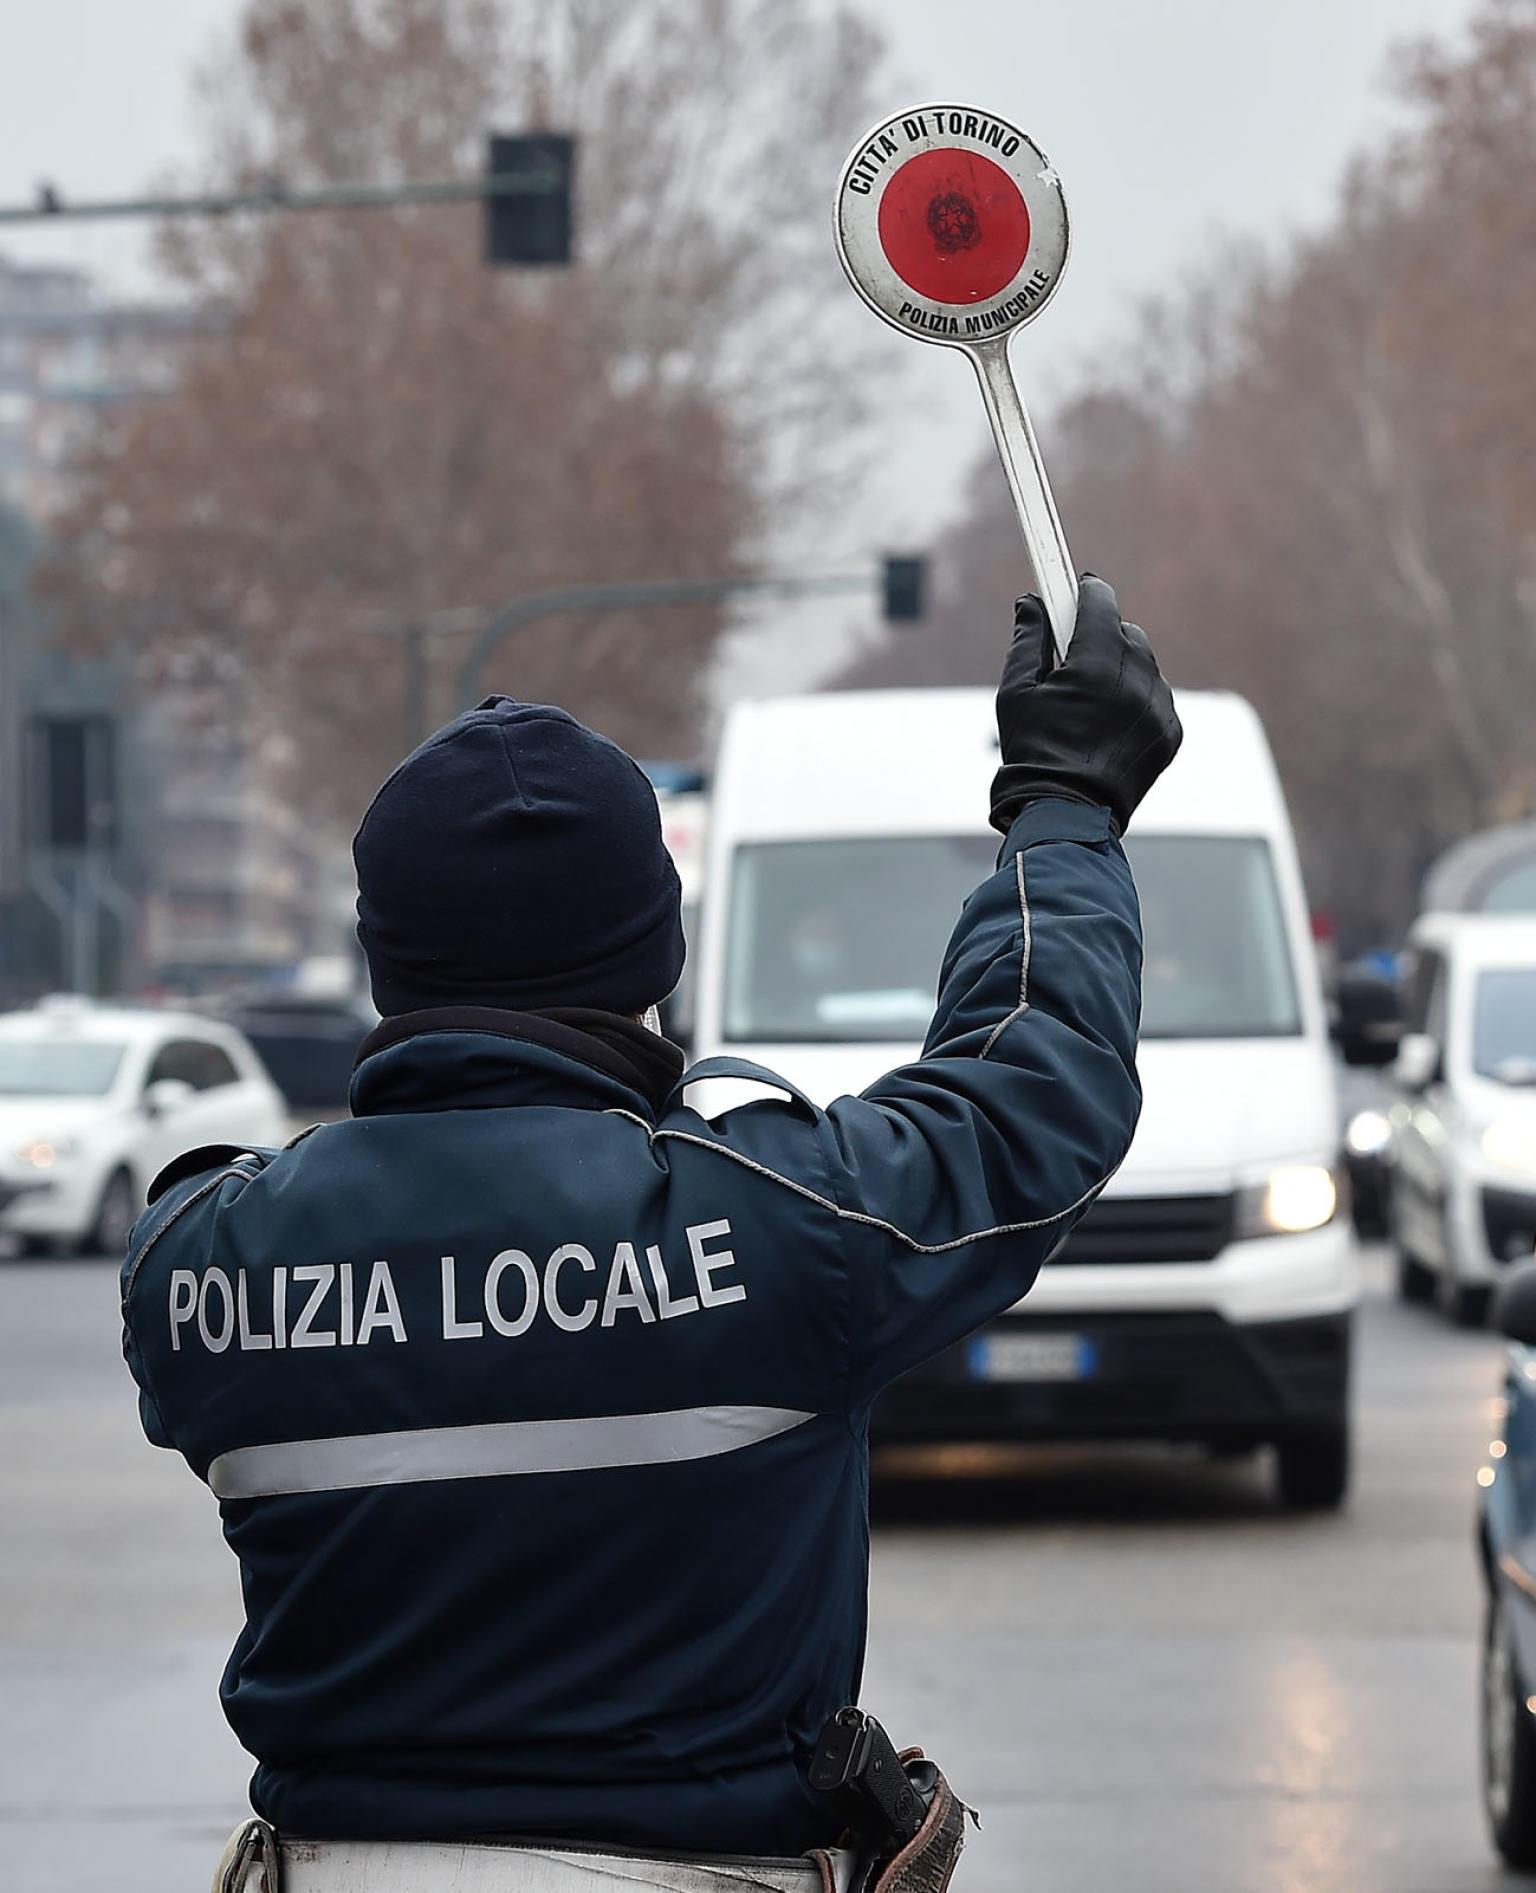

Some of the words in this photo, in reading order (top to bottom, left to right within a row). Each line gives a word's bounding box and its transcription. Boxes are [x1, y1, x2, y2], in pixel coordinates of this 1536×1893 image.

[849, 128, 899, 196] CITTA'
[902, 115, 929, 142] DI
[933, 111, 1020, 158] TORINO
[898, 301, 959, 334] POLIZIA
[966, 268, 1050, 334] MUNICIPALE
[169, 1260, 408, 1354] POLIZIA
[441, 1218, 748, 1341] LOCALE
